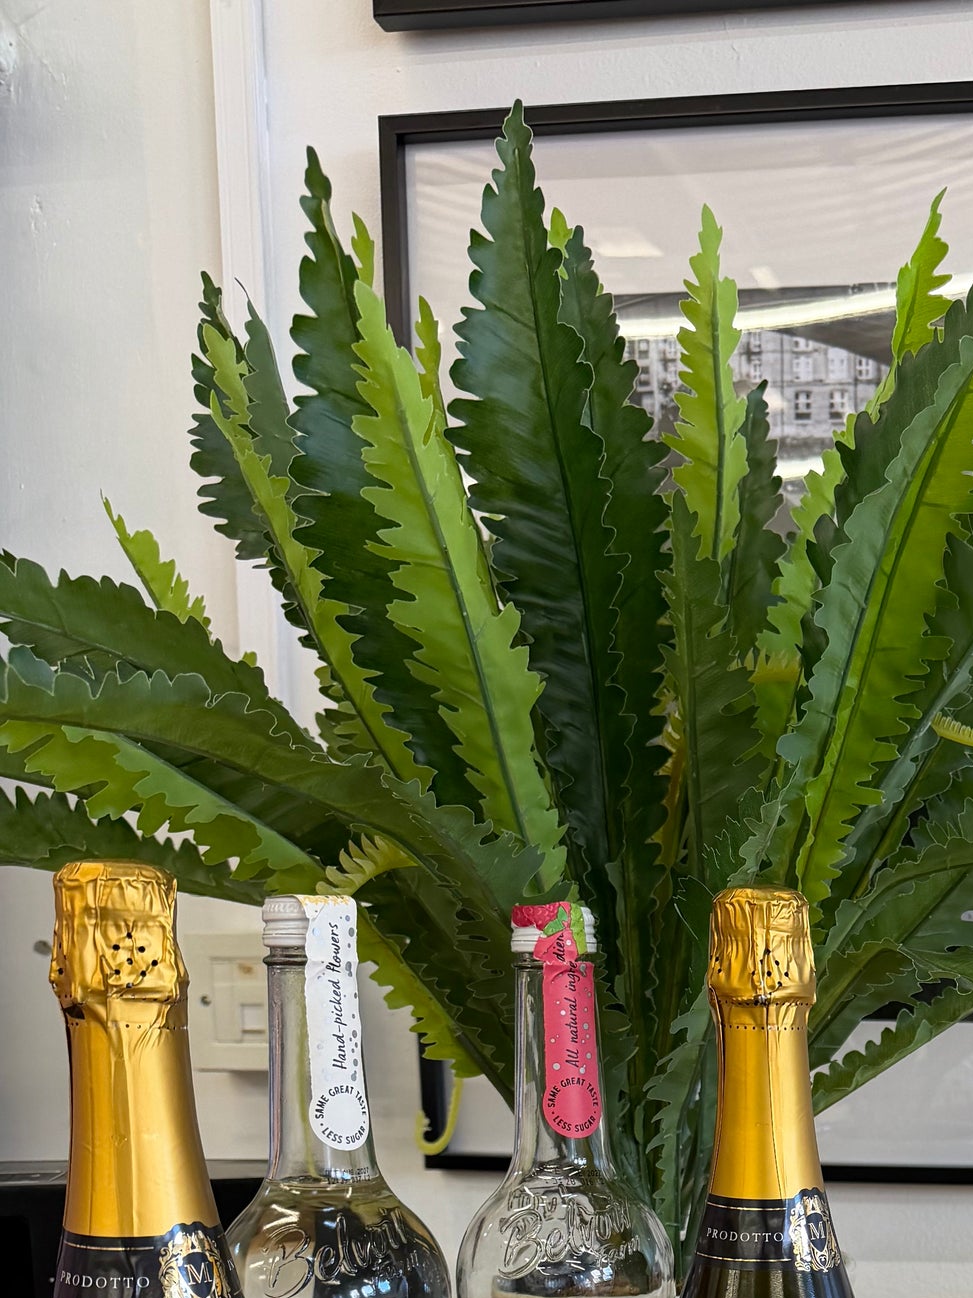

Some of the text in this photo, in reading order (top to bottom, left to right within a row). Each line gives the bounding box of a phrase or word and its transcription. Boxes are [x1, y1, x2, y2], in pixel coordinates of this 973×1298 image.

[325, 922, 348, 1069] Hand-picked flowers
[564, 997, 578, 1043] natural
[565, 1048, 579, 1068] All
[315, 1085, 367, 1119] SAME GREAT TASTE
[547, 1077, 599, 1108] SAME GREAT TASTE
[552, 1115, 596, 1132] LESS SUGAR
[321, 1125, 366, 1145] LESS SUGAR
[706, 1227, 784, 1243] PRODOTTO
[808, 1221, 826, 1241] M
[60, 1270, 151, 1290] PRODOTTO
[184, 1261, 213, 1286] M
